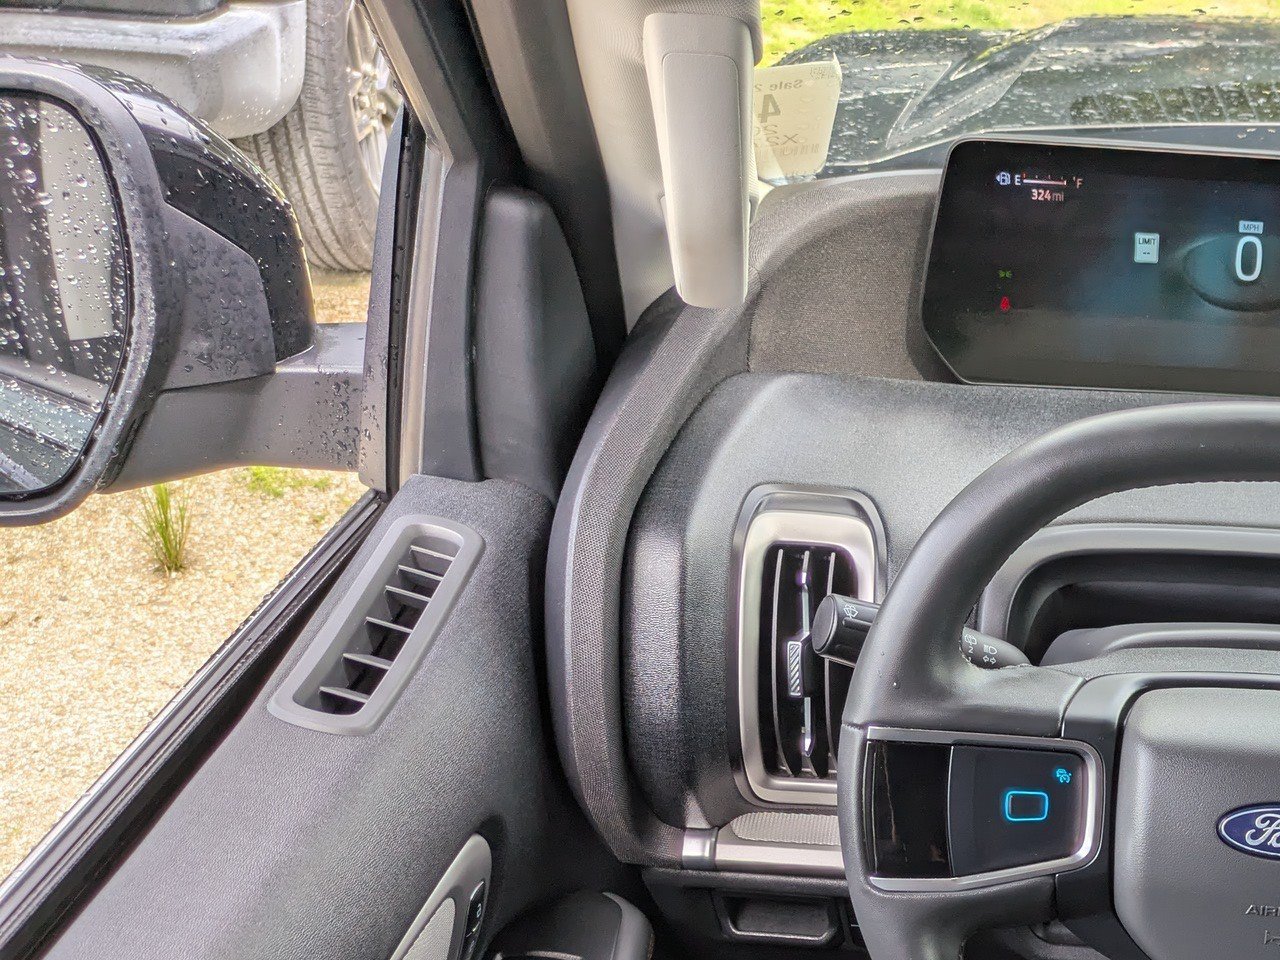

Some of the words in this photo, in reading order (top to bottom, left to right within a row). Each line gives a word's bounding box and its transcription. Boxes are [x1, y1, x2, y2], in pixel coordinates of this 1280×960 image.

[1014, 174, 1021, 186] E
[1031, 188, 1051, 201] 324
[1243, 223, 1259, 232] MPH
[1138, 236, 1156, 247] LIMIT
[1235, 235, 1264, 282] 0
